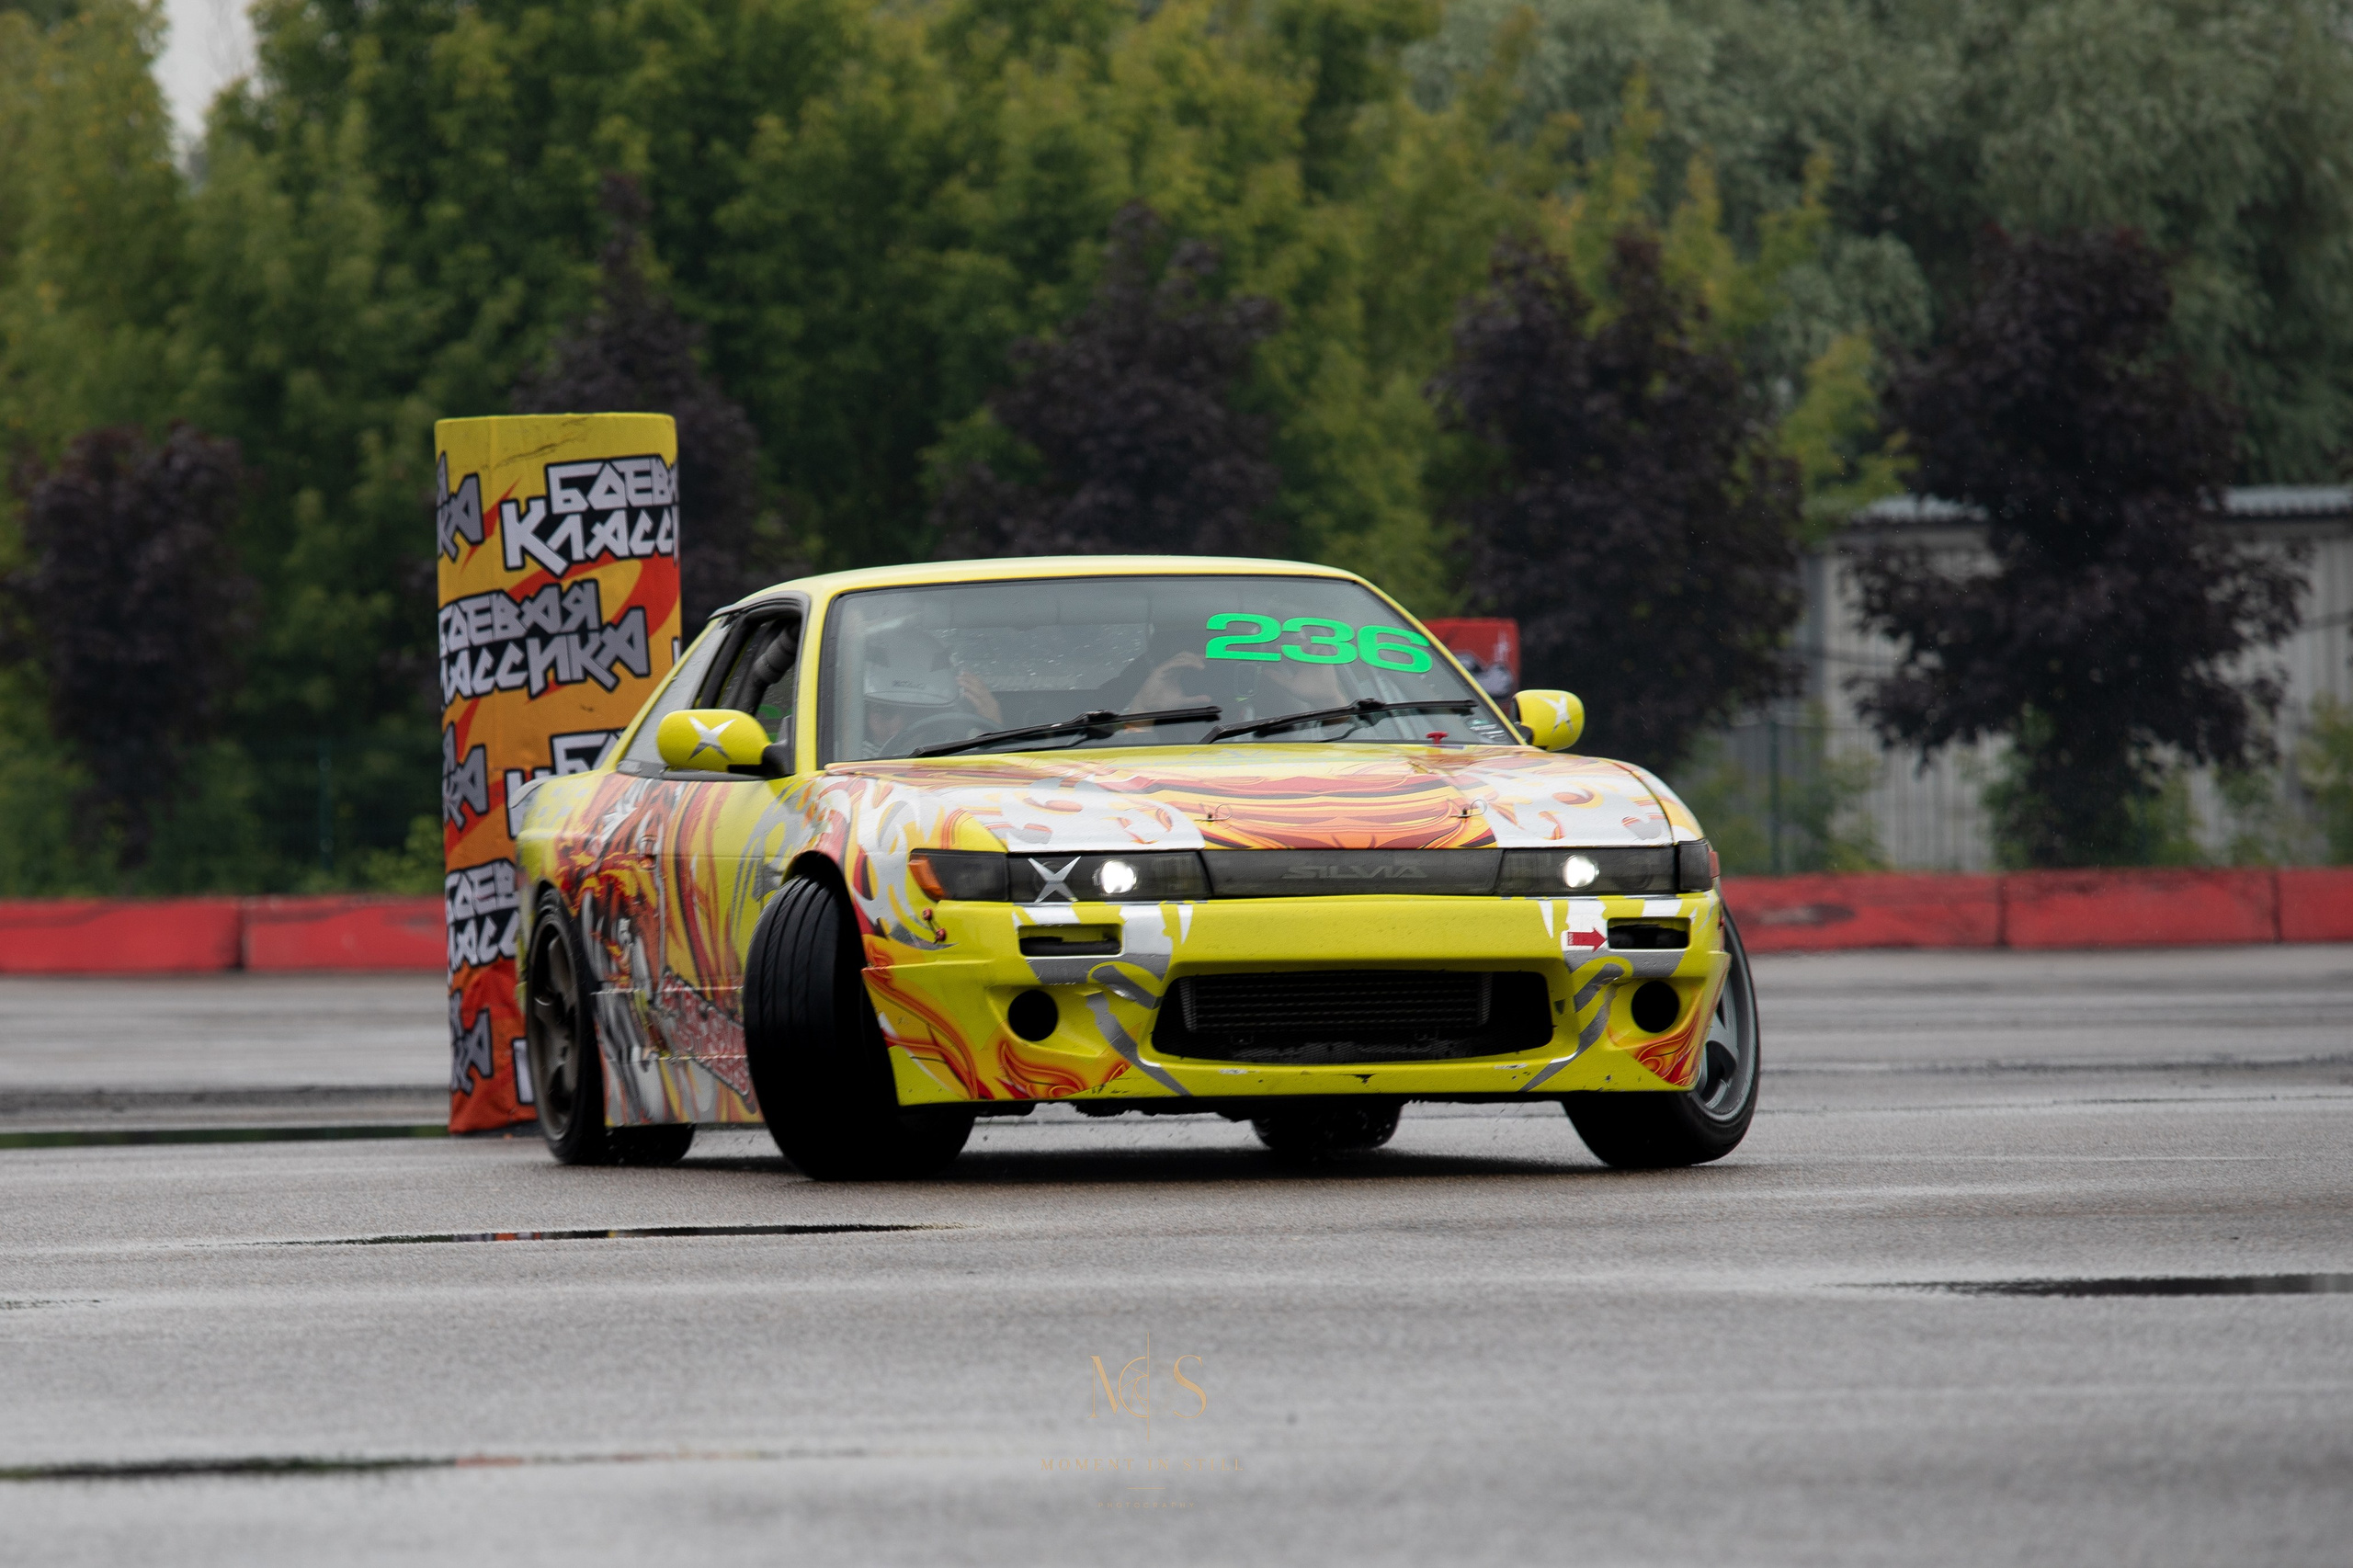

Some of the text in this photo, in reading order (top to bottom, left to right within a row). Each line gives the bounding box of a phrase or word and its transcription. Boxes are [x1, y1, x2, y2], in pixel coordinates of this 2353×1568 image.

[500, 497, 678, 576] КЛАСС
[1205, 612, 1433, 674] 236
[1282, 864, 1428, 880] SILVIA
